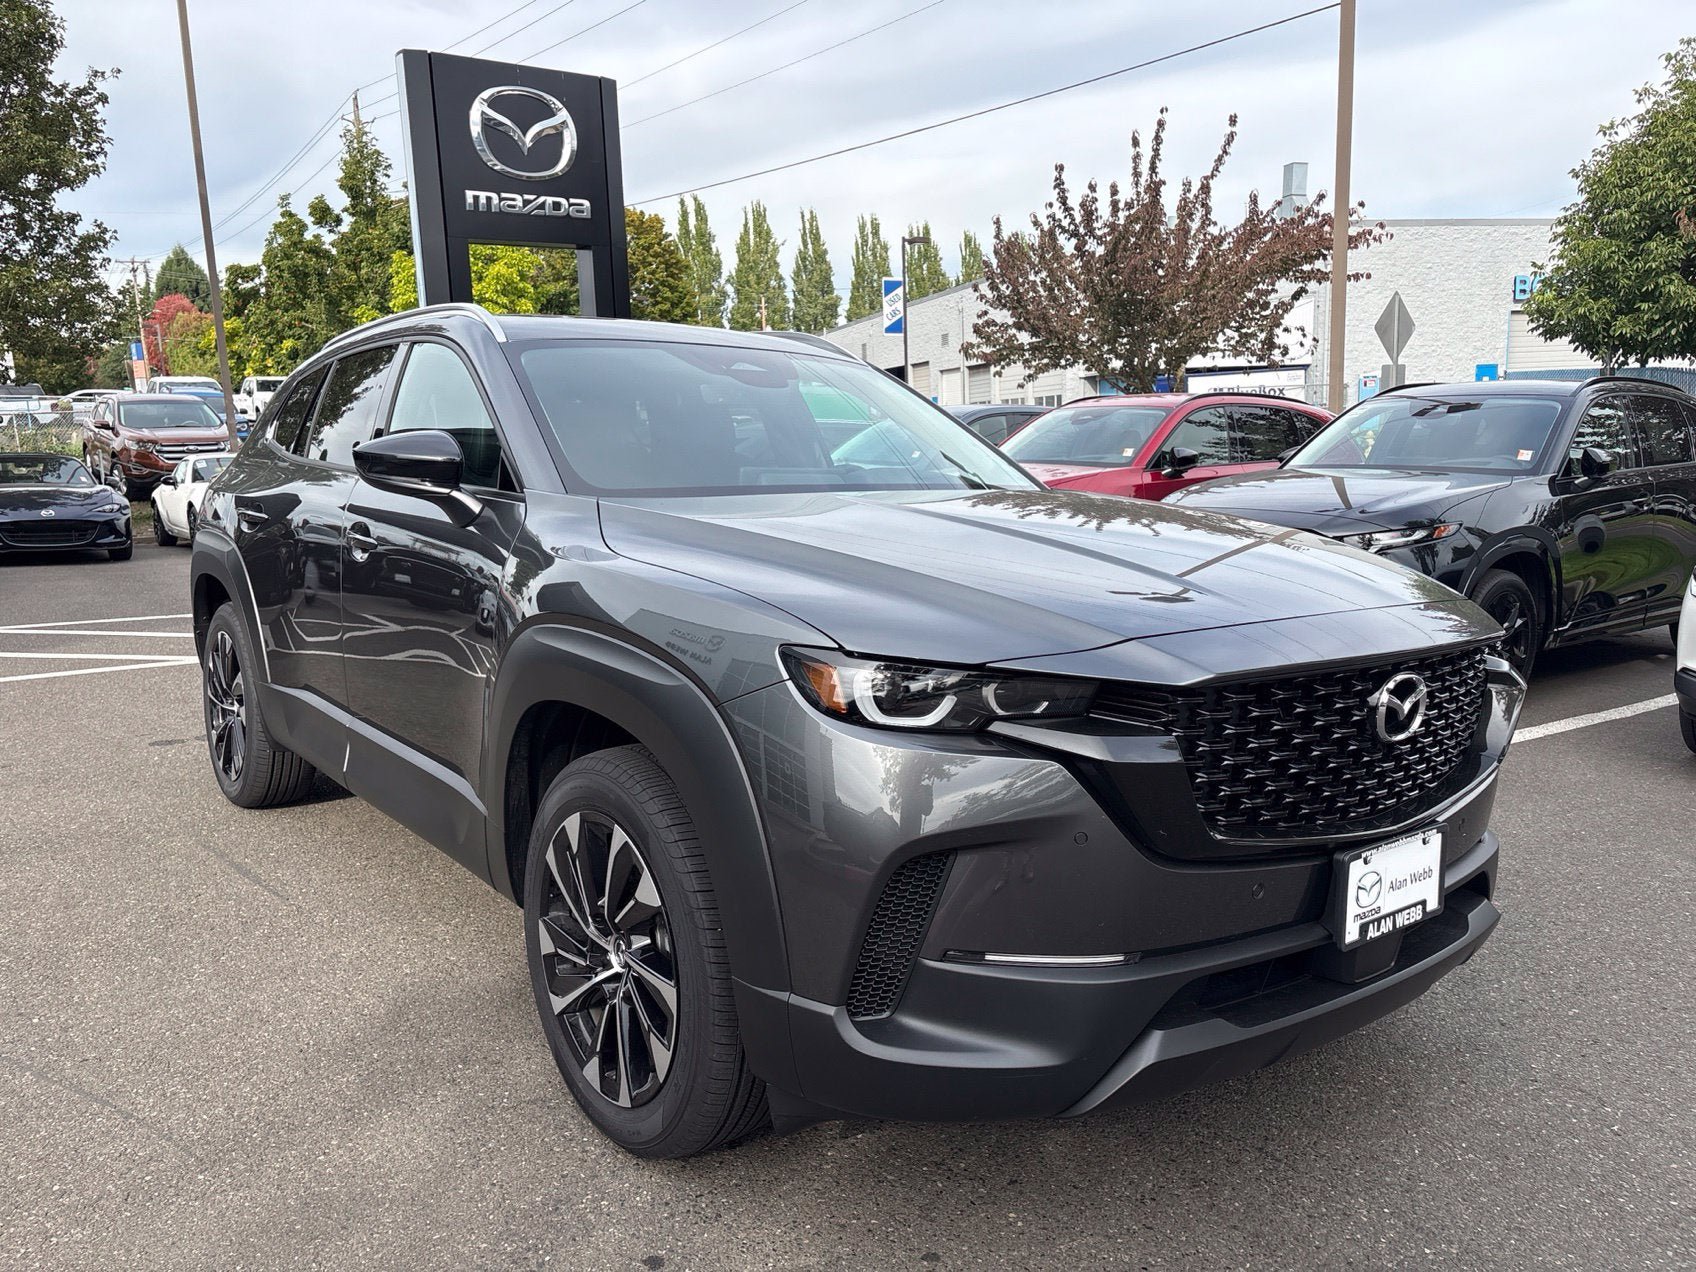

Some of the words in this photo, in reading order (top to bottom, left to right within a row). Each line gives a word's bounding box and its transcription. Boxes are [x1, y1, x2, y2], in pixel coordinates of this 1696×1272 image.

[464, 189, 592, 219] mazda
[885, 293, 901, 307] USED
[885, 307, 901, 321] CARS
[1387, 876, 1409, 894] Alan
[1410, 866, 1433, 885] Webb
[1353, 906, 1381, 923] mazda
[1366, 917, 1394, 940] ALAN
[1395, 905, 1423, 928] WEBB
